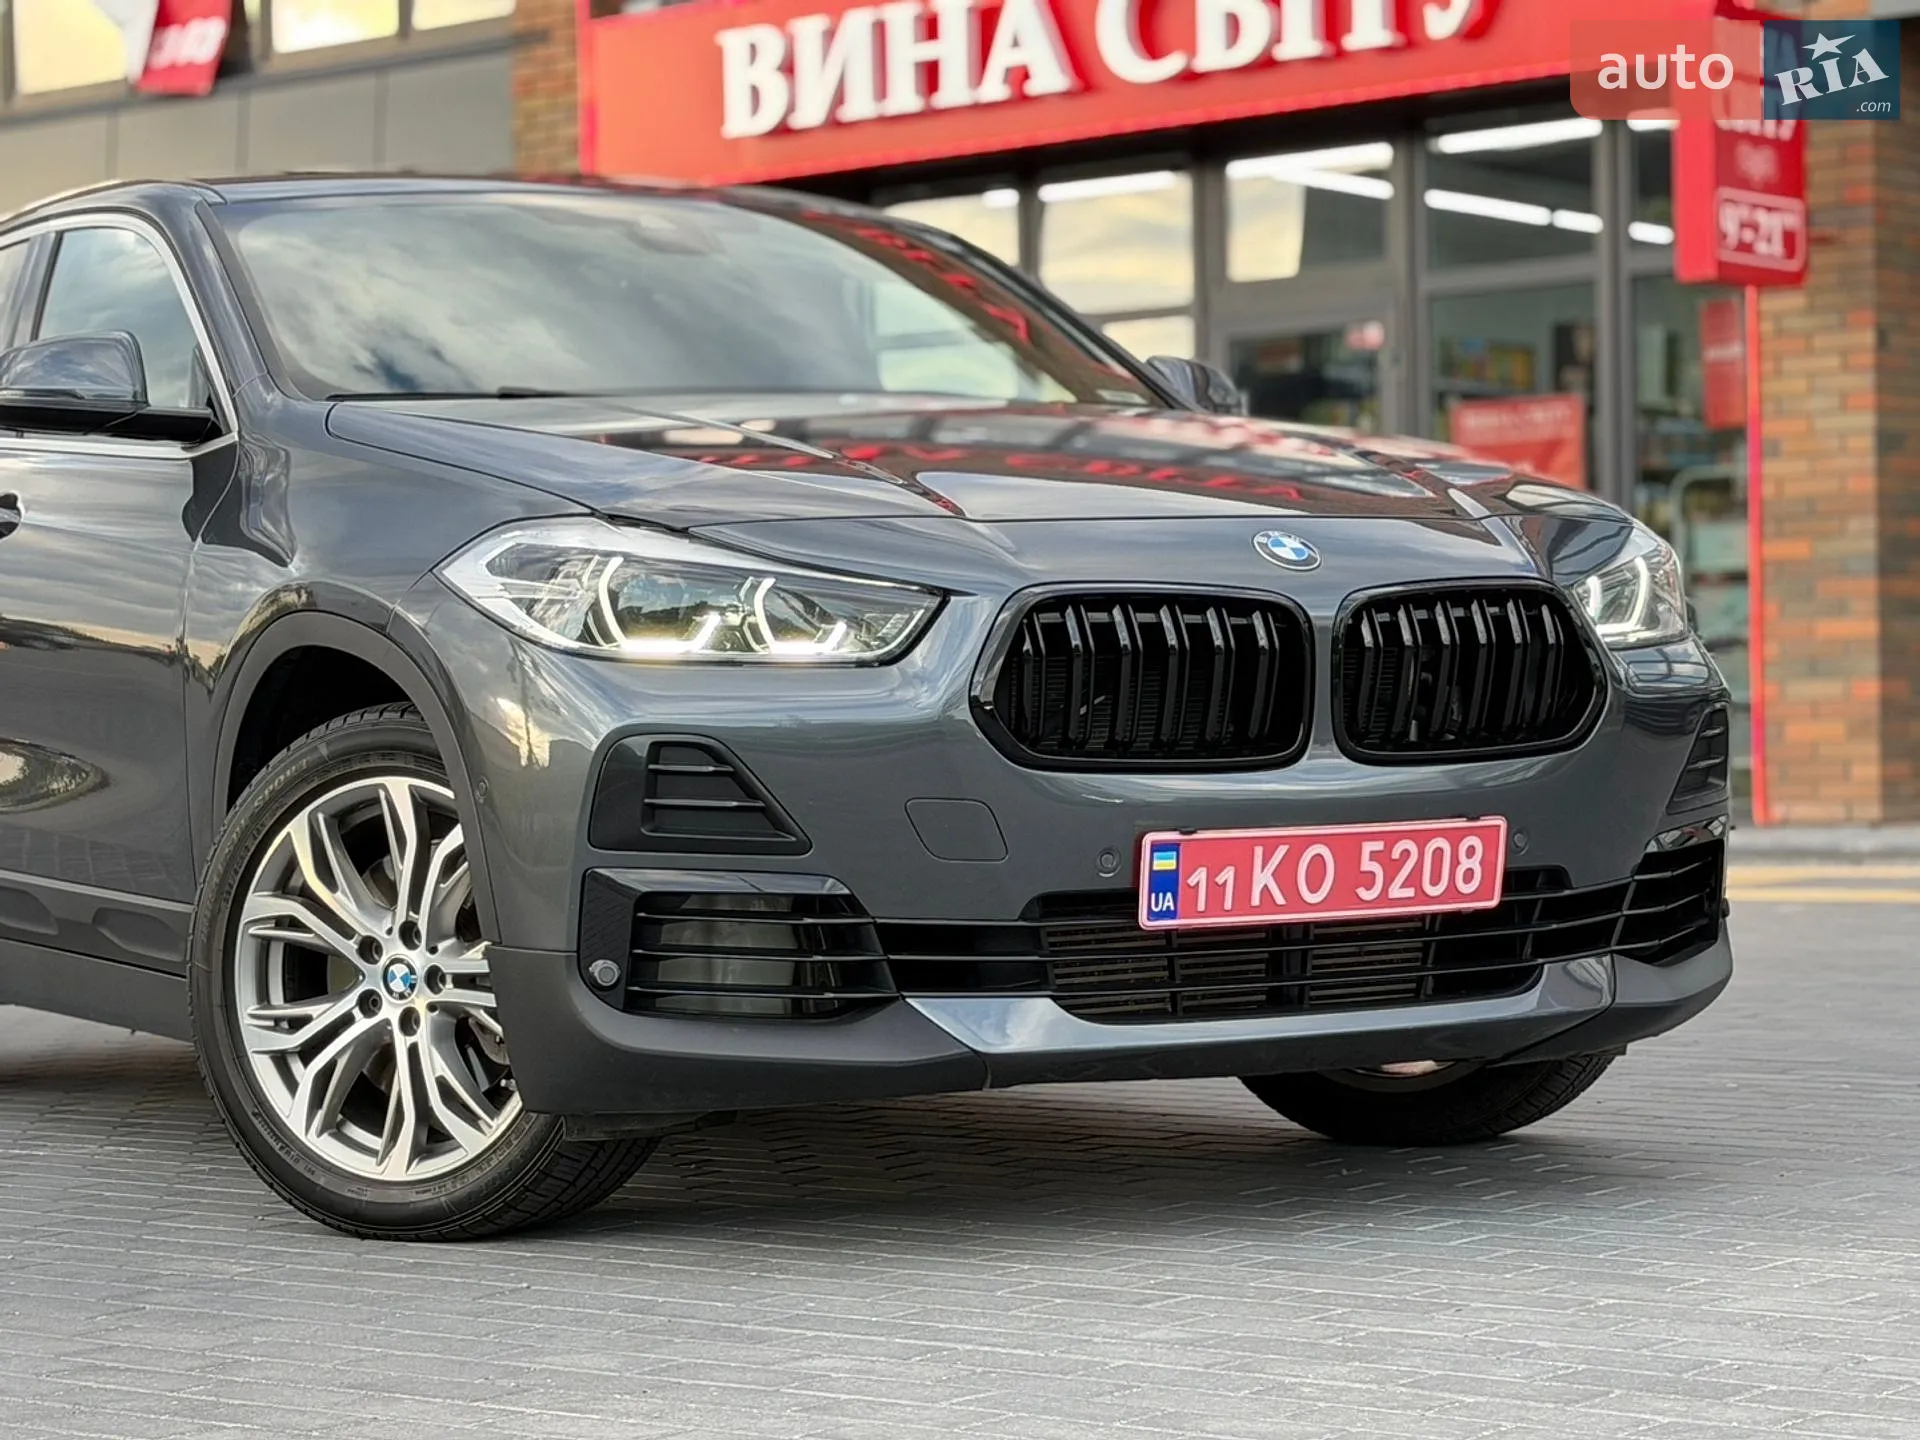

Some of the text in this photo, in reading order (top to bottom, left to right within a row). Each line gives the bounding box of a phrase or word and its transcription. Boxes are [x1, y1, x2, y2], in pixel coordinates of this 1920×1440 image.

[714, 0, 1072, 139] ВИНА
[1150, 892, 1175, 912] UA
[1186, 835, 1483, 912] 11 KO 5208
